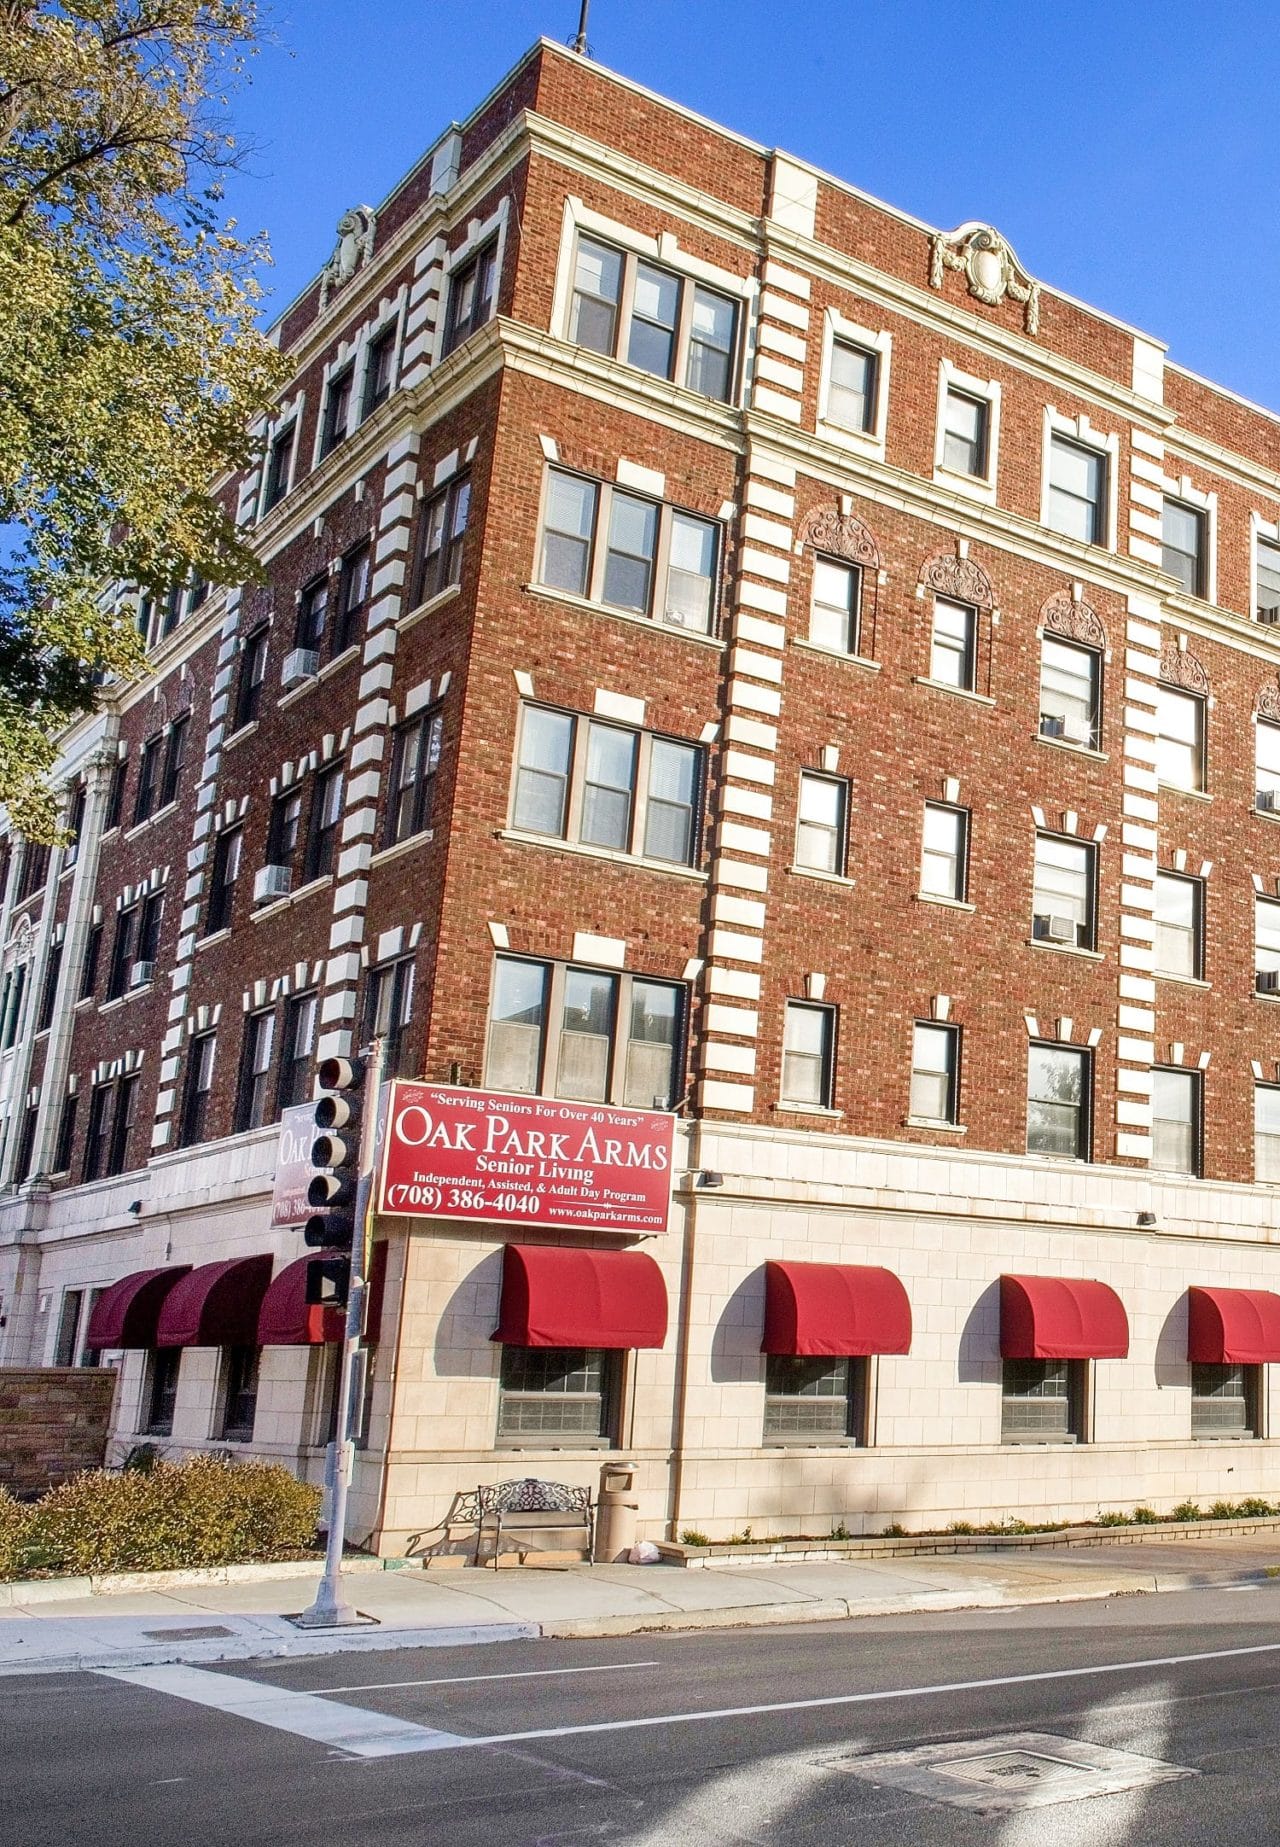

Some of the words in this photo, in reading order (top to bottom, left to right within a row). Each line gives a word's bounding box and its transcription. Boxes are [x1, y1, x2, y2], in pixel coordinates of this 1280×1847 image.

[488, 1099, 532, 1115] Seniors
[535, 1104, 557, 1117] For
[560, 1107, 588, 1121] Over
[591, 1111, 604, 1123] 40
[395, 1105, 476, 1152] OAK
[483, 1115, 570, 1161] PARK
[573, 1126, 667, 1170] ARMS
[476, 1155, 534, 1175] Senior
[538, 1161, 594, 1185] Living
[387, 1184, 442, 1210] (708)
[447, 1189, 540, 1214] 386-4040
[413, 1171, 486, 1188] Independent,
[488, 1178, 533, 1193] Assisted,
[536, 1182, 546, 1193] &
[549, 1184, 577, 1196] Adult
[580, 1187, 600, 1200] Day
[603, 1189, 646, 1202] Program
[549, 1206, 663, 1224] www.oakparkarms.com
